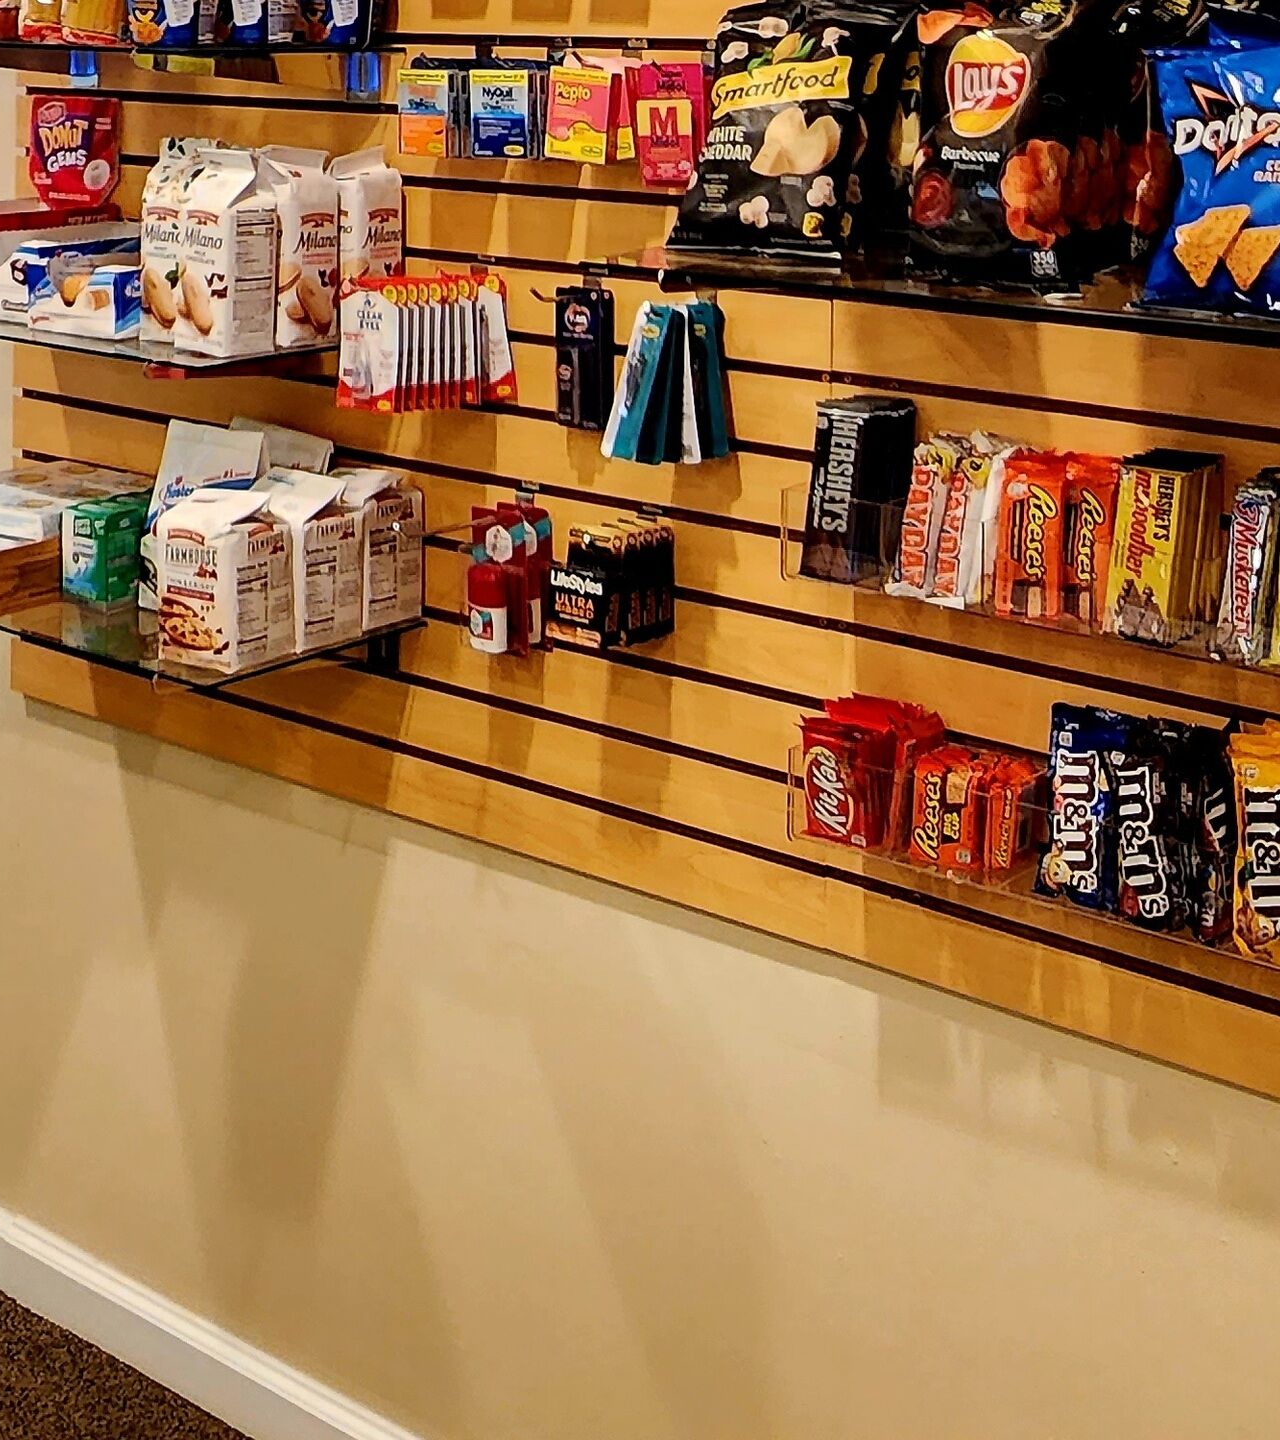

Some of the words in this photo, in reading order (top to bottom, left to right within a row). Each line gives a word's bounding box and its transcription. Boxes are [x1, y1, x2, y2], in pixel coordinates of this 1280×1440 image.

[553, 82, 591, 101] Pepto
[716, 67, 839, 106] Smartfood
[38, 119, 89, 156] DONUT
[47, 149, 88, 173] GEMS
[941, 145, 1001, 163] Barbecue
[181, 229, 223, 251] Milano
[357, 309, 383, 321] CLEAR
[358, 320, 380, 331] EYES
[1024, 484, 1058, 582] Reese's
[1075, 487, 1106, 586] Reese's
[165, 543, 218, 567] FARMHOUSE
[555, 592, 595, 612] ULTRA
[913, 771, 943, 860] Reese's
